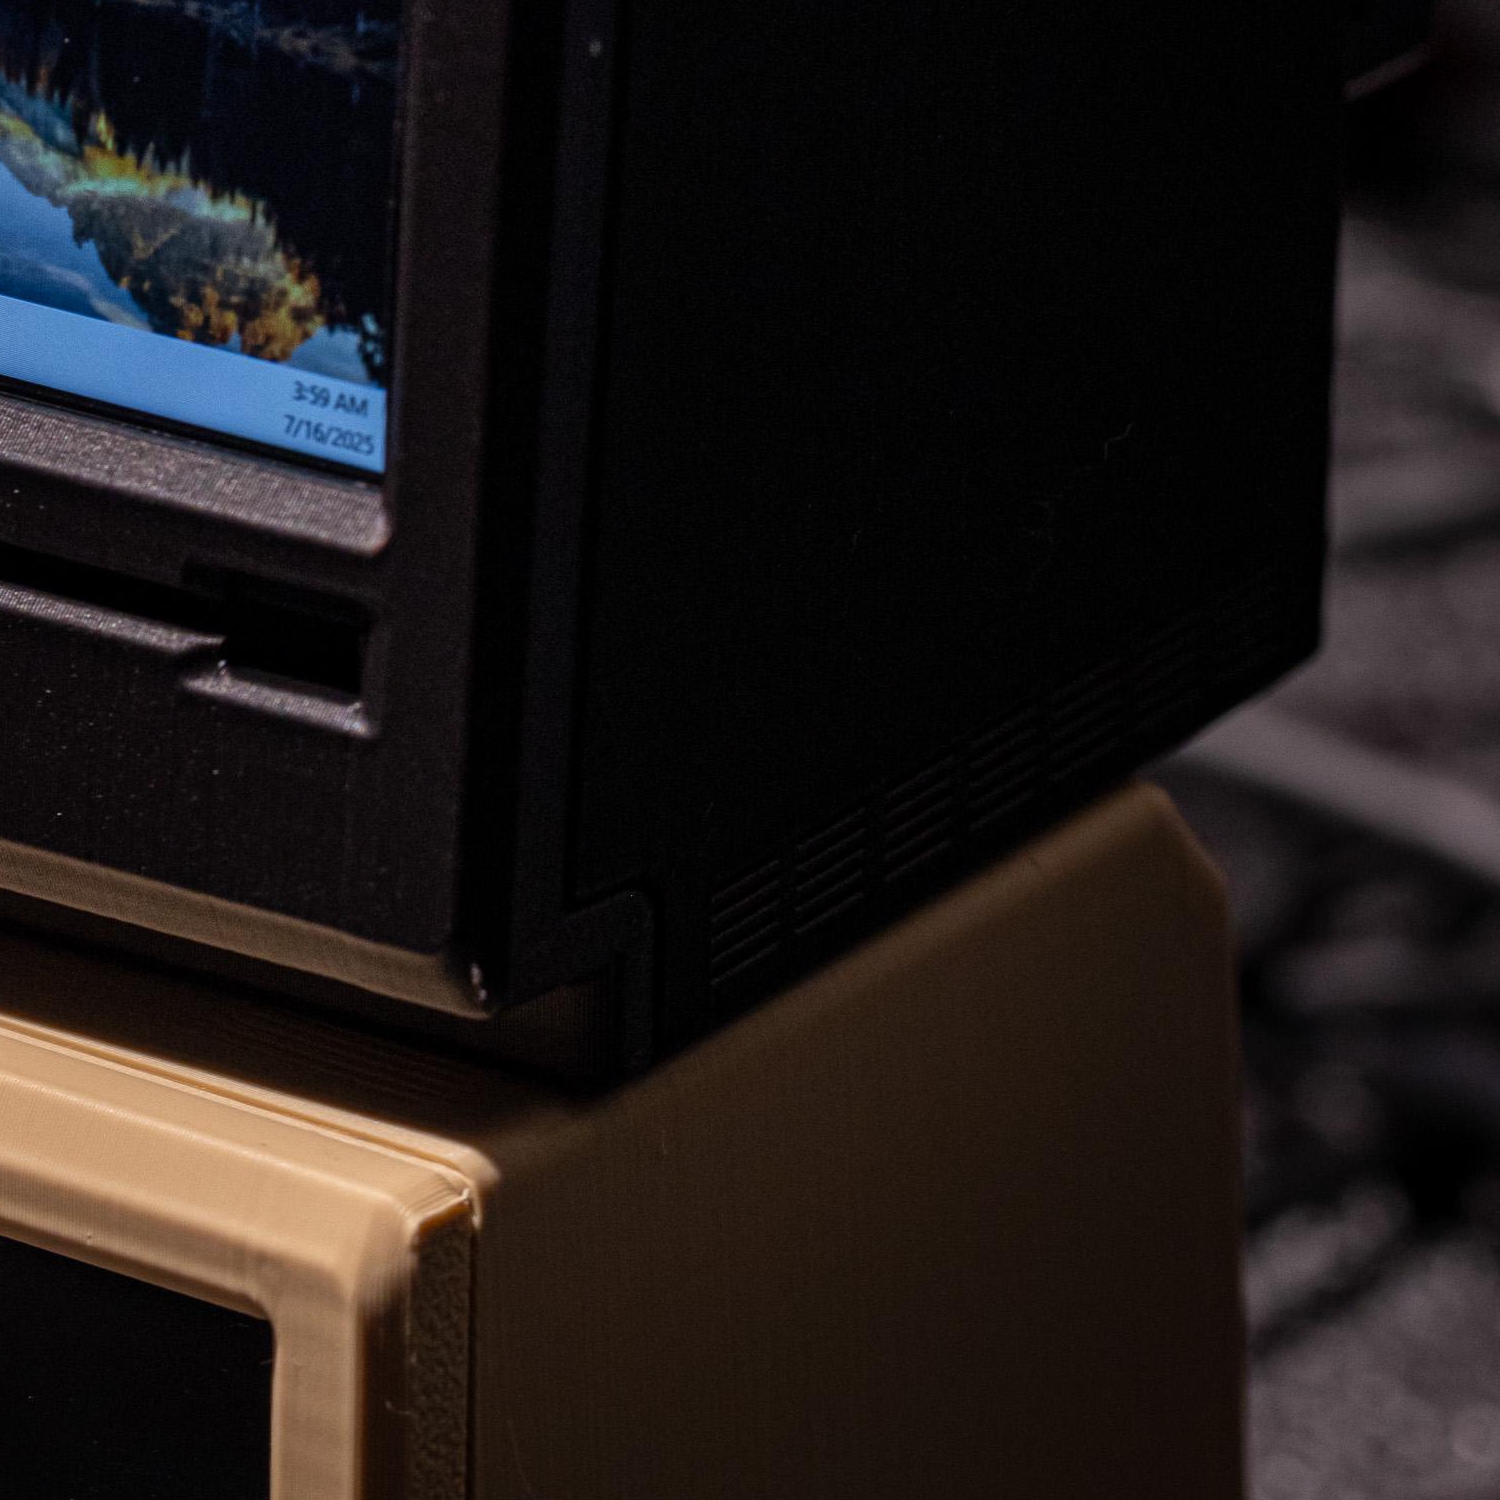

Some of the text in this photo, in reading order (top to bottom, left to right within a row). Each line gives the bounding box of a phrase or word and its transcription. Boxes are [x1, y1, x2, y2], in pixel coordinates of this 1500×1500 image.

[293, 381, 368, 417] 3:59 AM
[284, 414, 375, 455] 7/16/2025
